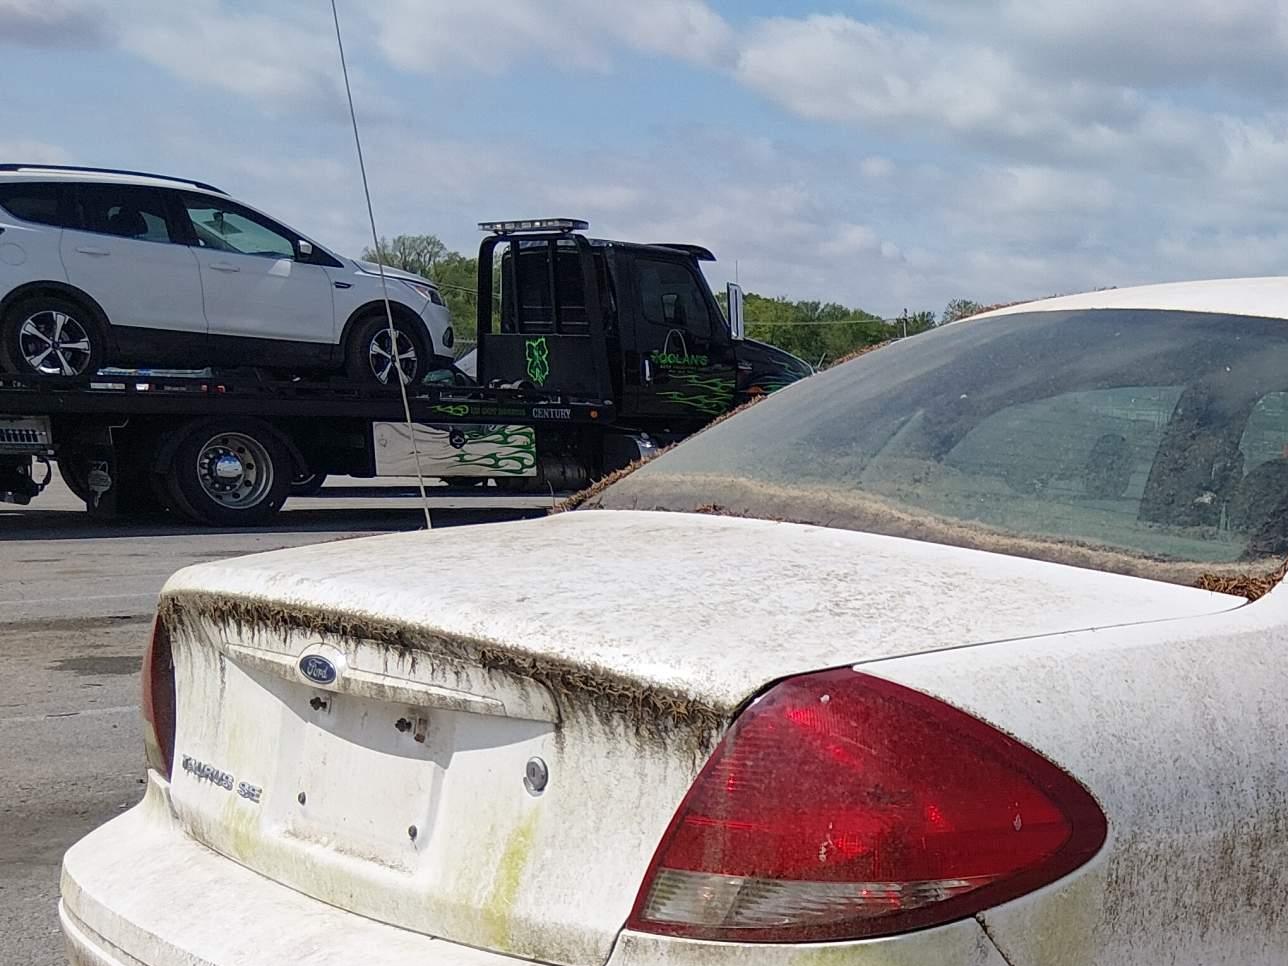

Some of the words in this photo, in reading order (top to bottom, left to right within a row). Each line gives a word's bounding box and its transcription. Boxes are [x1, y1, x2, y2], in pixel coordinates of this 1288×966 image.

[532, 406, 571, 419] CENTURY
[306, 658, 330, 679] Ford
[182, 753, 234, 791] TAURUS
[237, 782, 263, 804] SE
